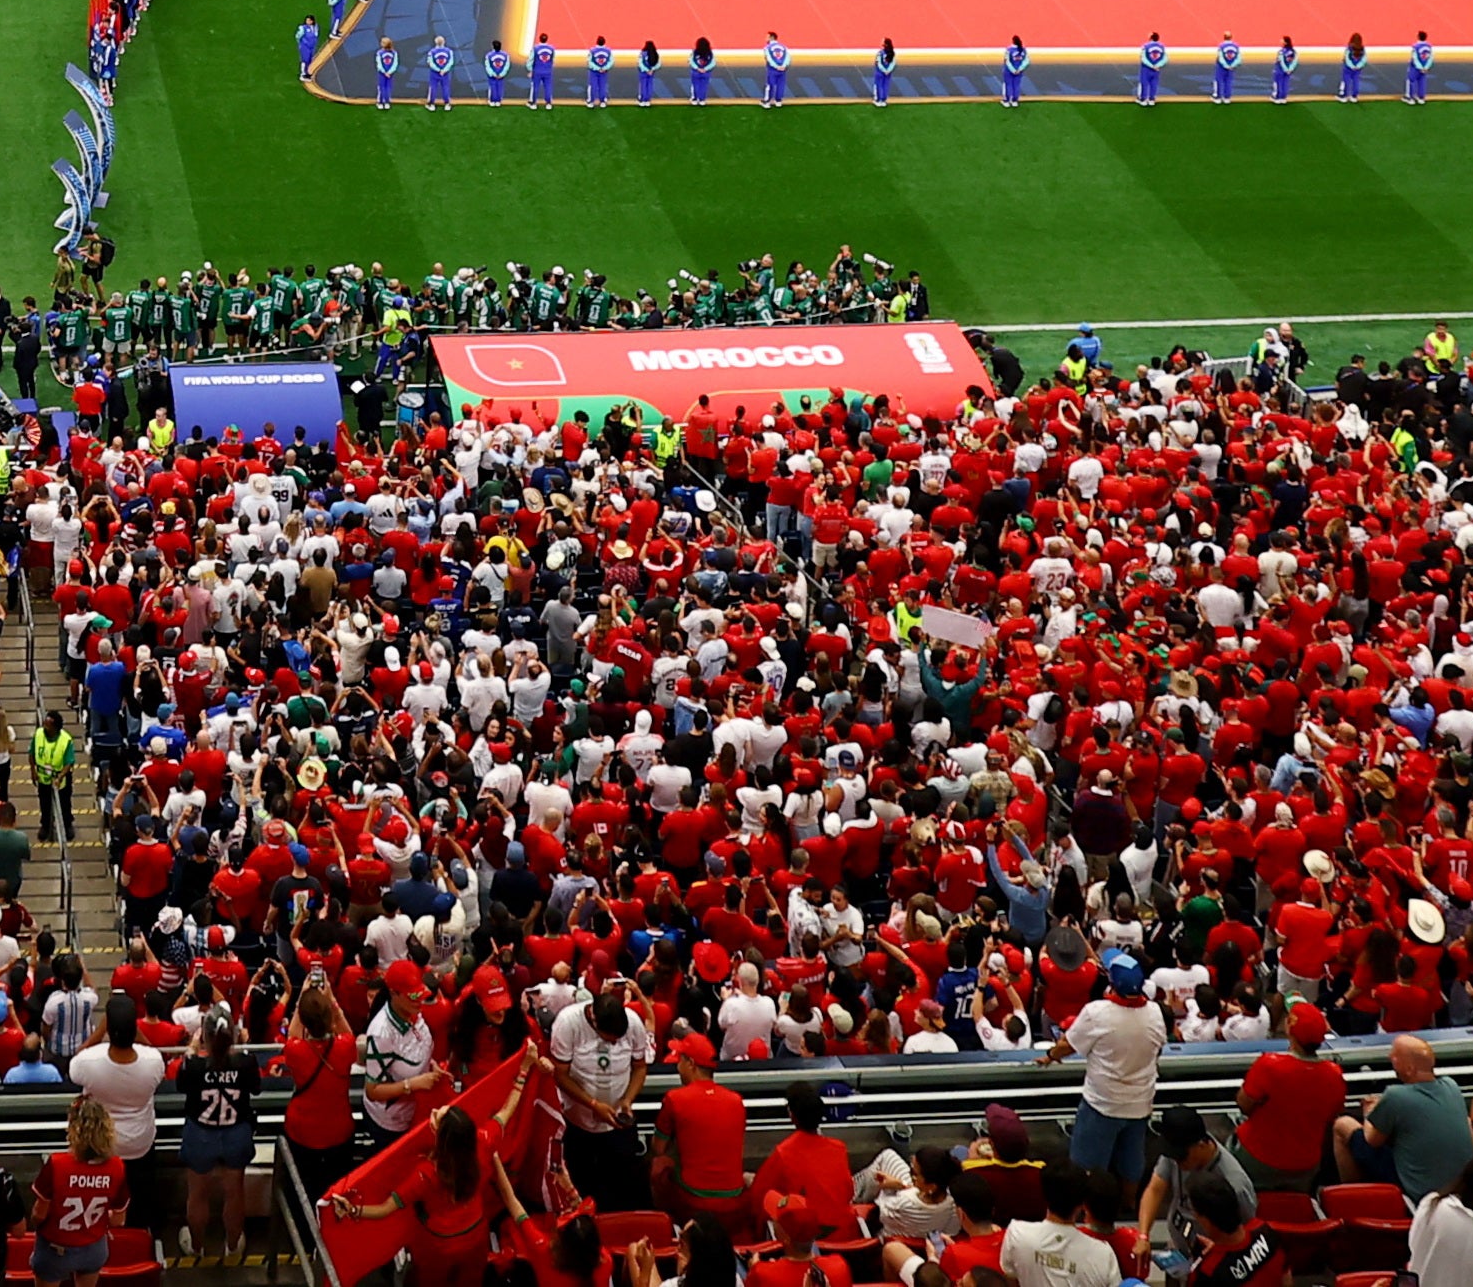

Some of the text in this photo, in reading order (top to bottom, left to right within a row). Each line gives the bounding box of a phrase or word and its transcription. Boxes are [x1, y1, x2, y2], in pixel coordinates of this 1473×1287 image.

[627, 344, 844, 371] MOROCCO
[183, 374, 326, 386] FIFA WORLD CUP 2026
[1048, 573, 1066, 588] 23
[617, 644, 642, 662] QATAR
[198, 1087, 241, 1126] 26
[69, 1174, 110, 1189] POWER
[58, 1195, 108, 1231] 26
